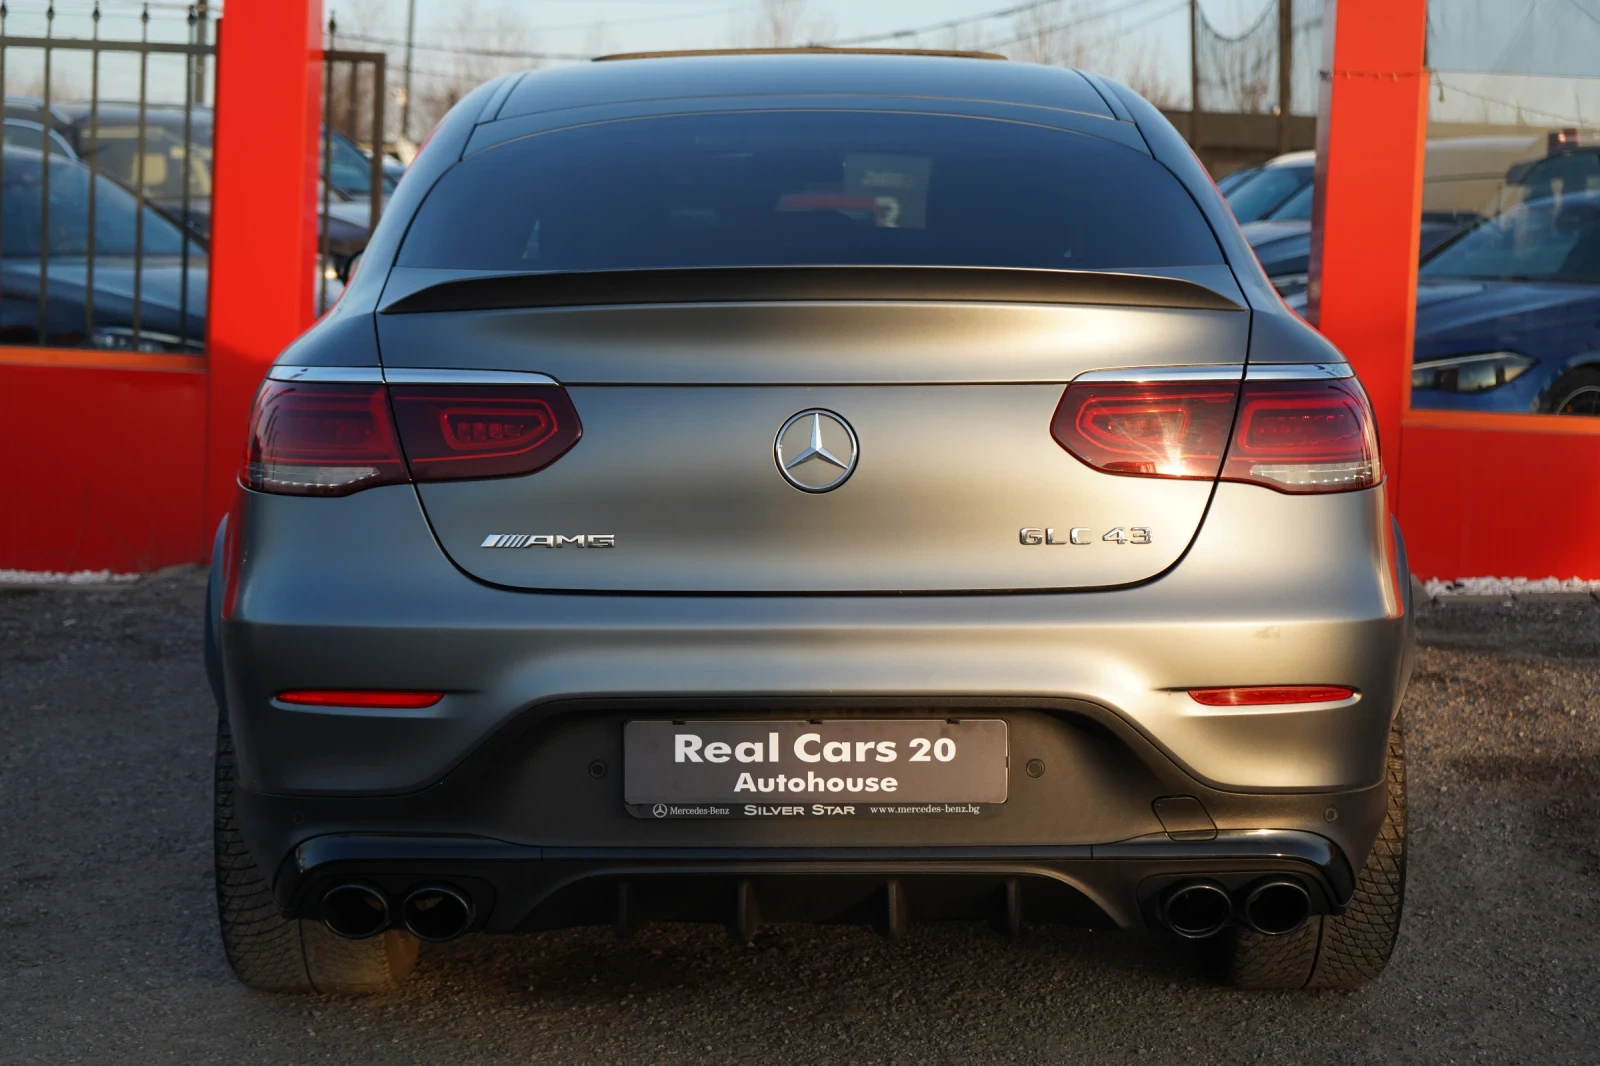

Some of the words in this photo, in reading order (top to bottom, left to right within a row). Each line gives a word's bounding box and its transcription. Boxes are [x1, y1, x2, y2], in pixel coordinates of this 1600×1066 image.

[1019, 527, 1092, 545] GLC
[1102, 527, 1153, 545] 43
[674, 732, 779, 763] Real
[793, 732, 898, 763] Cars
[908, 737, 956, 763] 20
[733, 772, 898, 793] Autohouse
[669, 805, 730, 816] Mercedes-Benz
[743, 804, 805, 816] SILVER
[811, 804, 856, 816] STAR
[869, 804, 980, 815] www.mercedes-benz.bg
